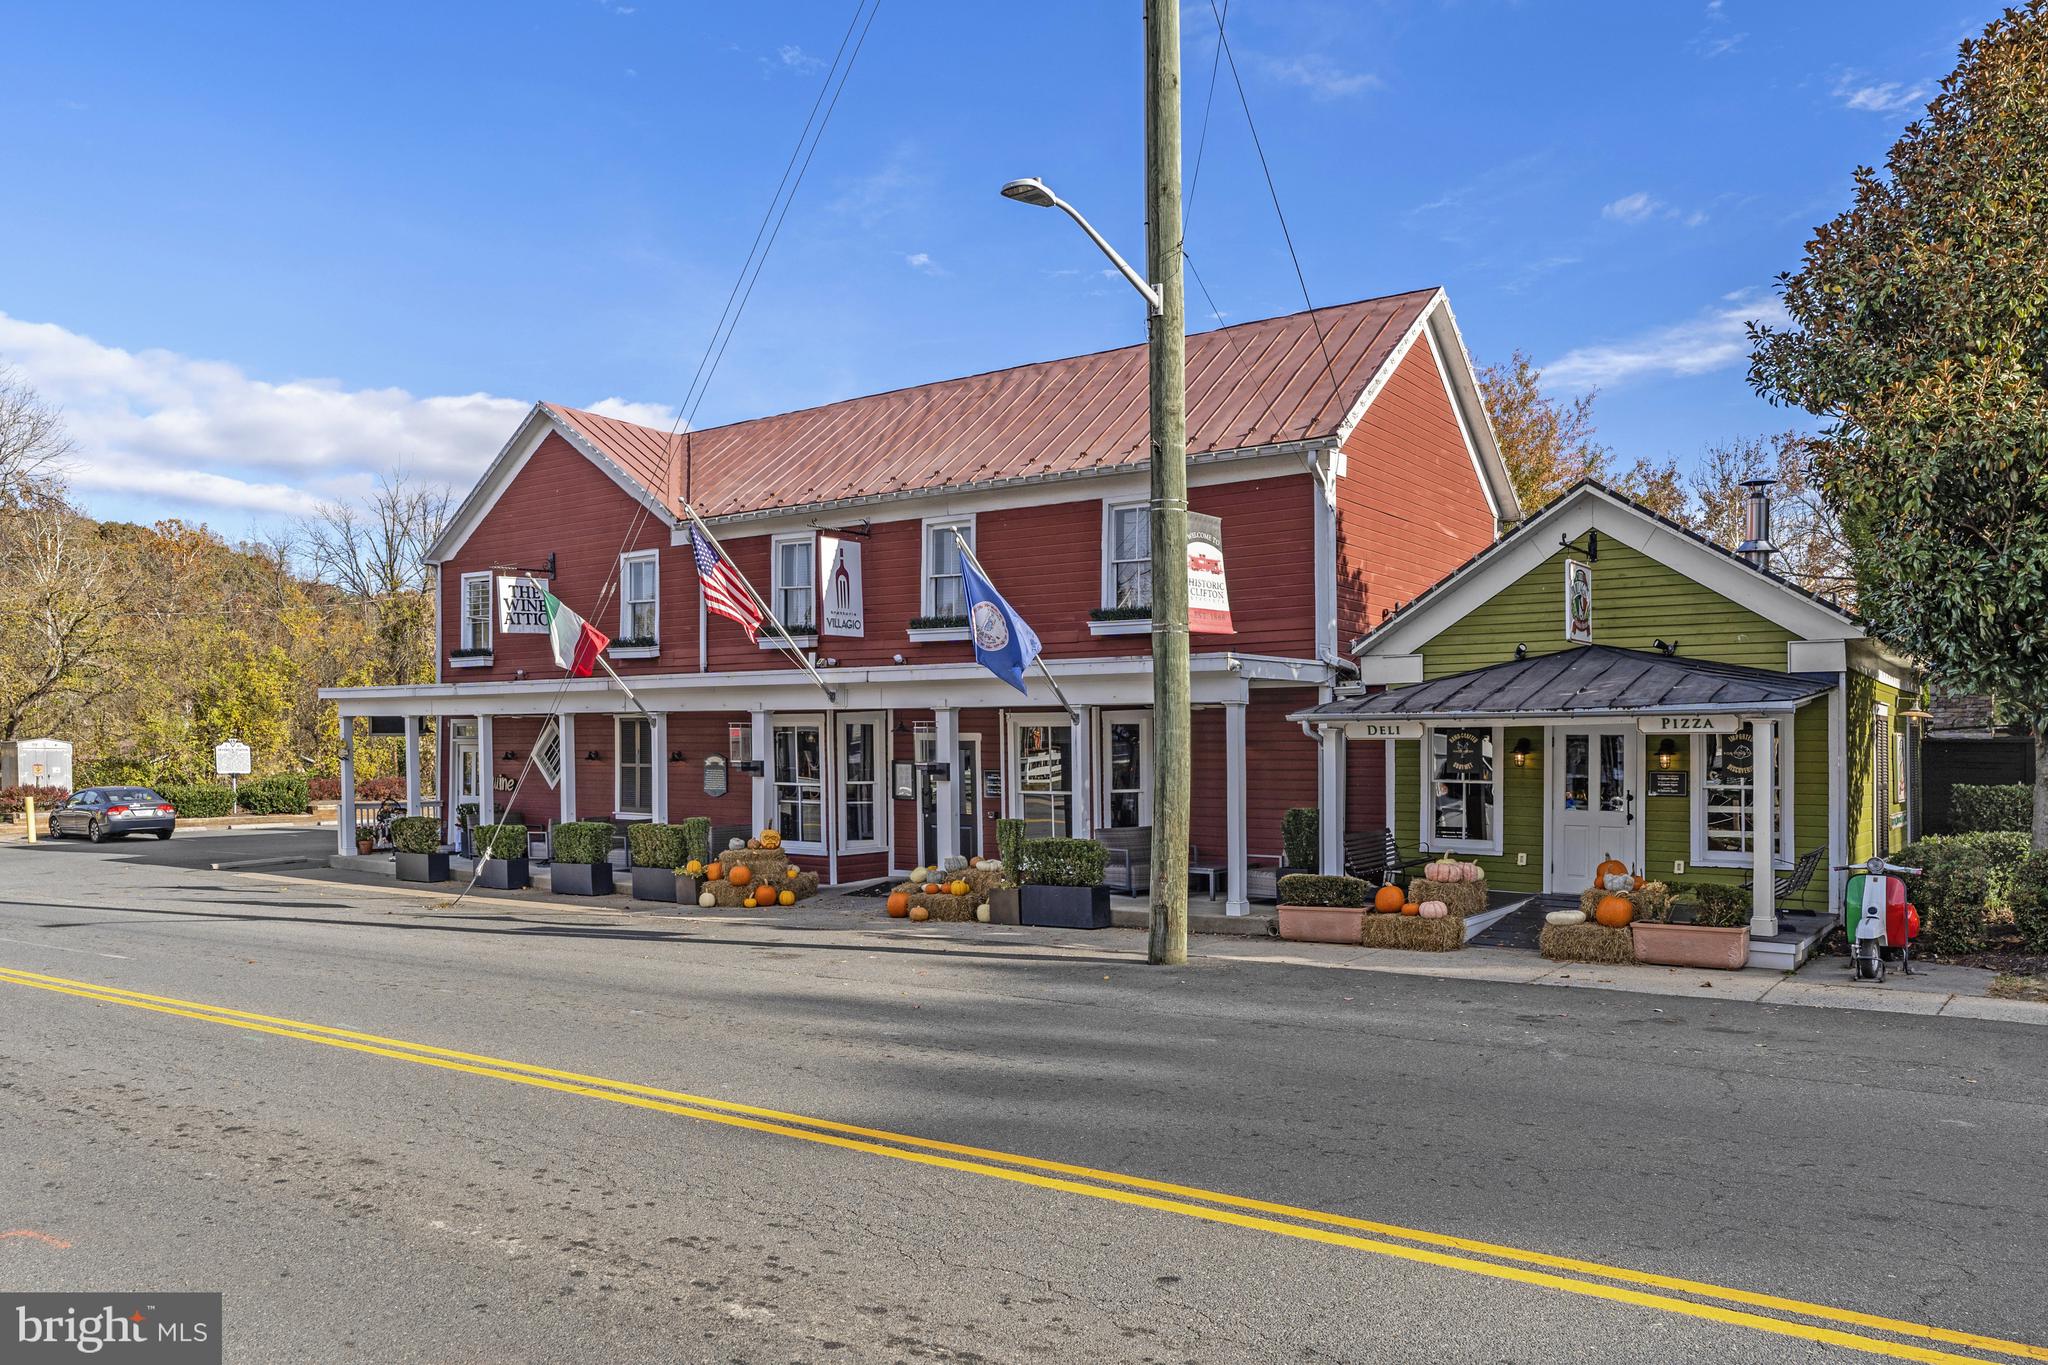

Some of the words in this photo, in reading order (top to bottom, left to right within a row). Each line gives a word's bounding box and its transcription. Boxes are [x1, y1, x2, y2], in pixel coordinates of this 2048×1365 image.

[1187, 531, 1211, 541] WELCOME
[1188, 577, 1225, 591] HISTORIC
[508, 585, 541, 599] THE
[1190, 587, 1224, 599] CLIFTON
[503, 598, 546, 612] WINE
[504, 612, 549, 626] ATTIC
[826, 617, 861, 630] VILLAGIO
[1367, 724, 1400, 736] DELI
[1661, 717, 1714, 730] PIZZA
